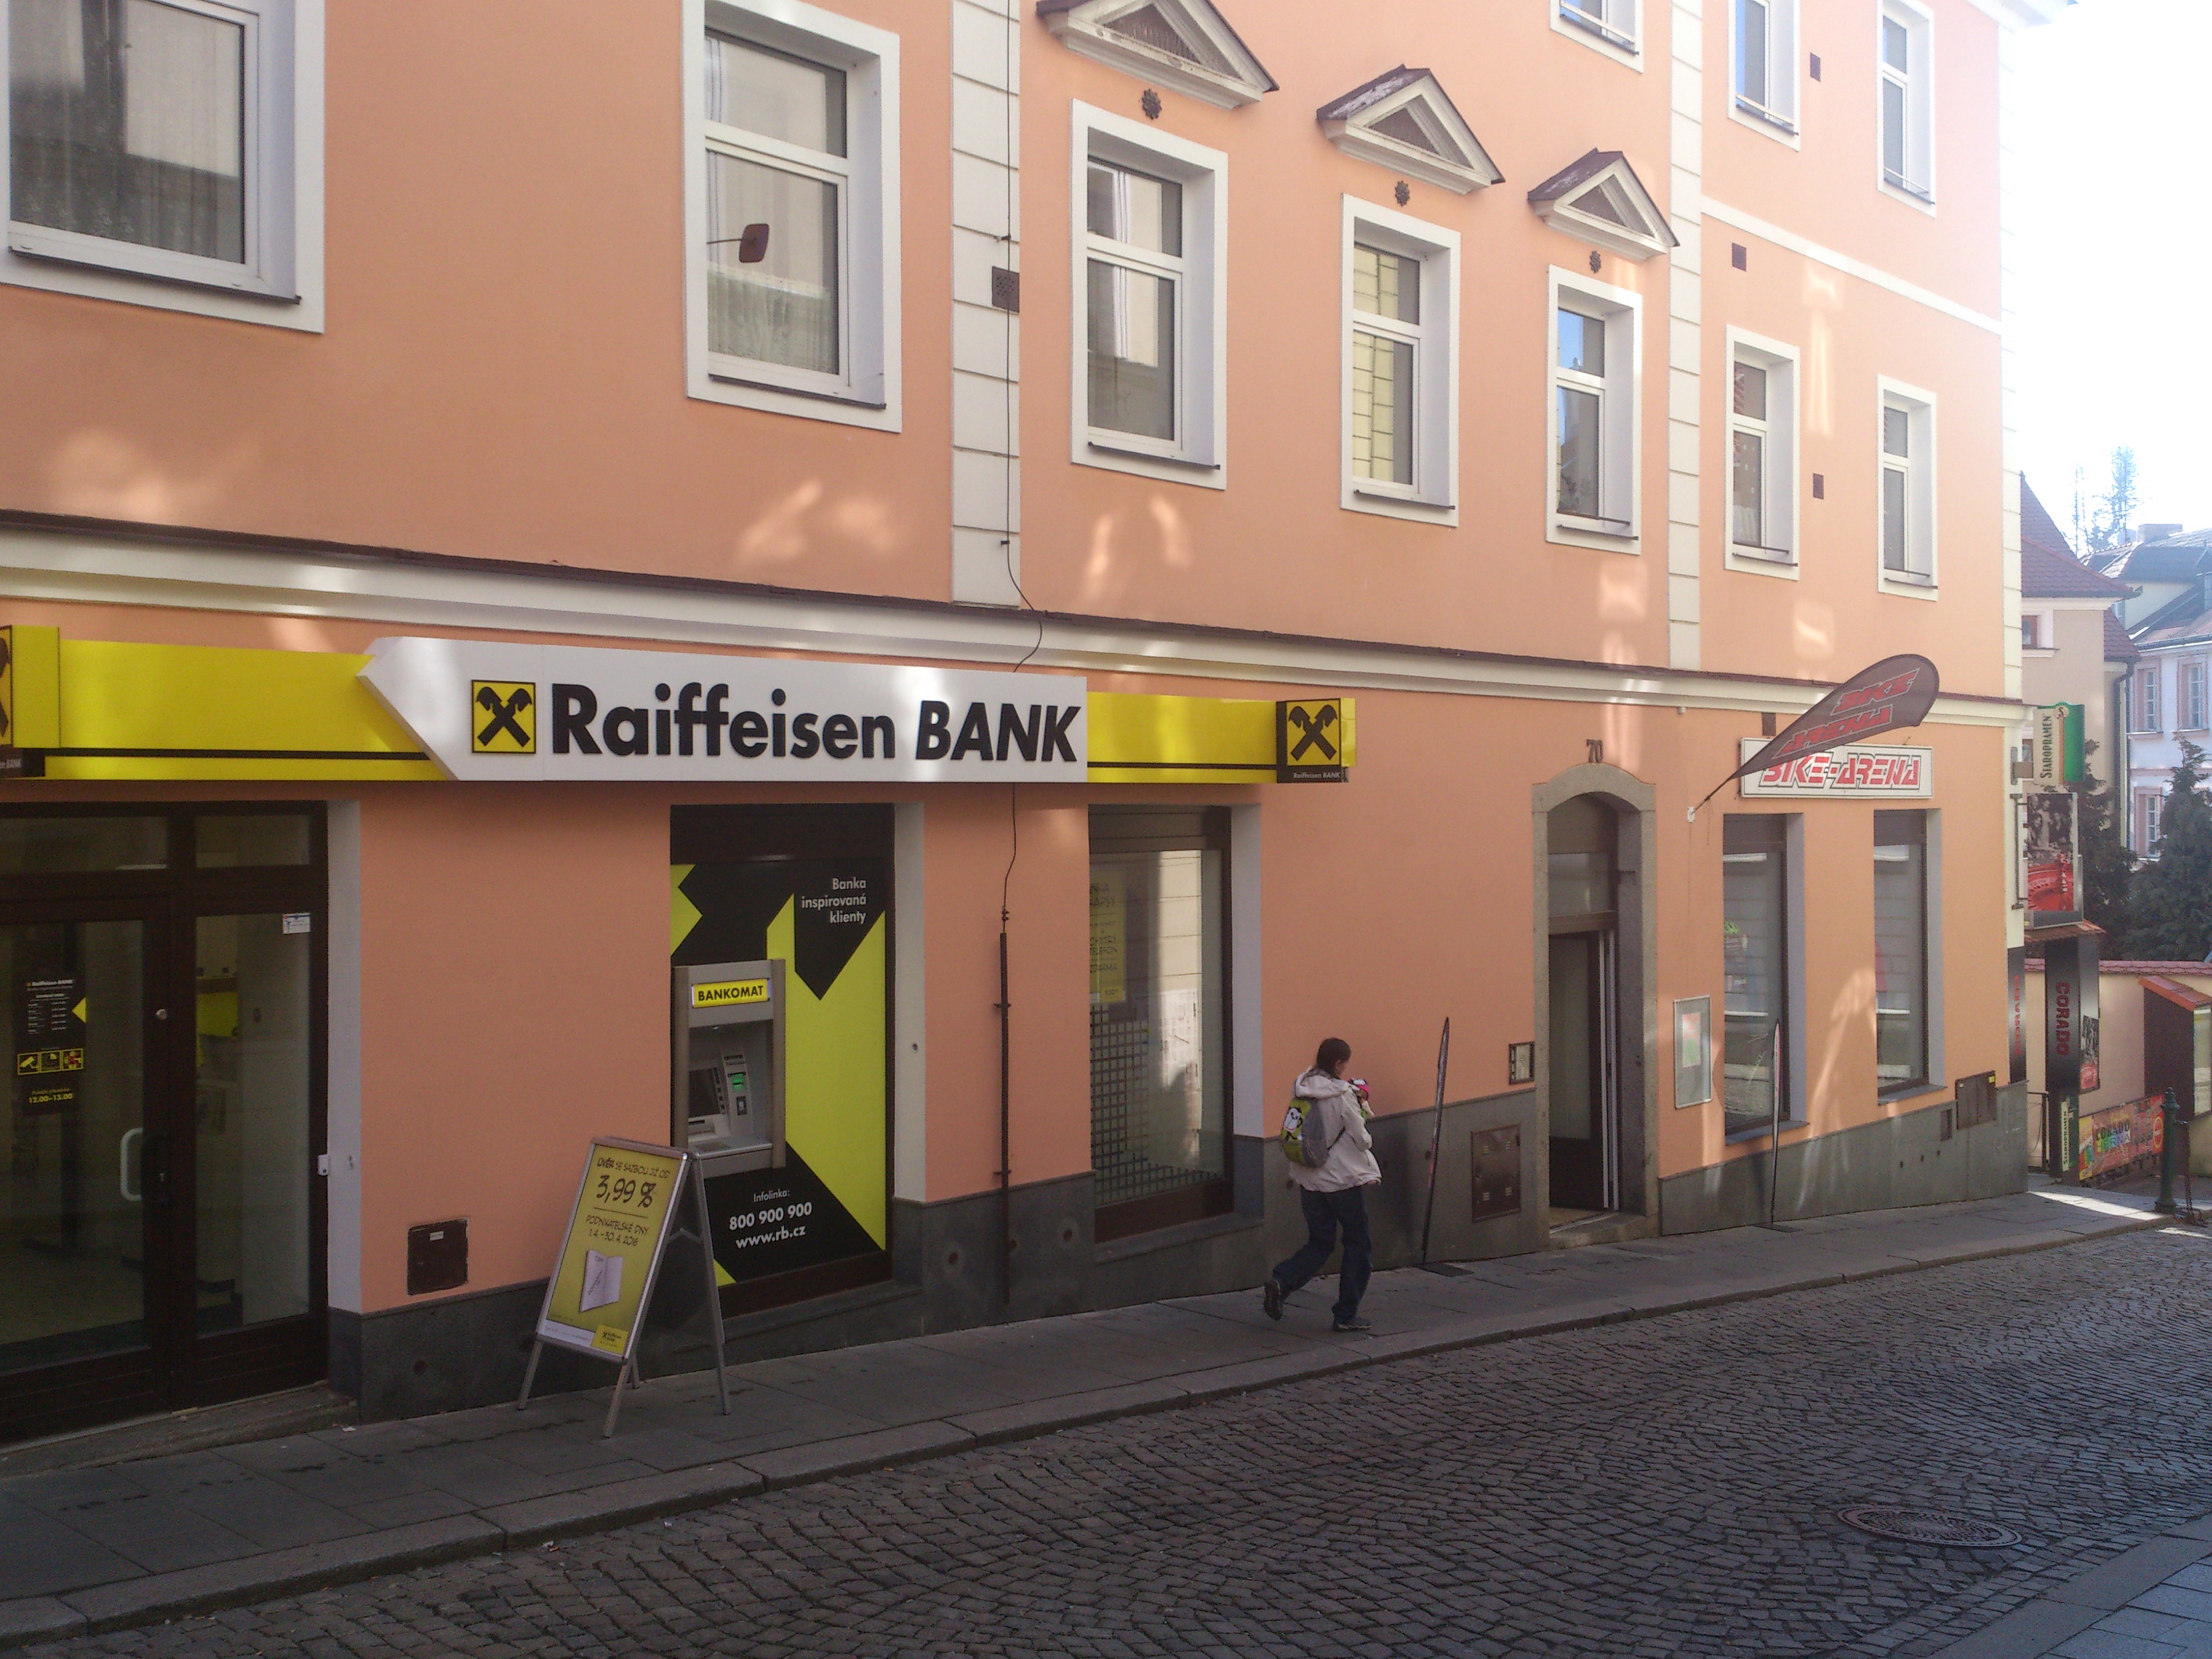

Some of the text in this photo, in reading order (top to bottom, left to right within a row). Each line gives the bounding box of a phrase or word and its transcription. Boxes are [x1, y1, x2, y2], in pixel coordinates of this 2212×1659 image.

[1832, 670, 1919, 714] BIKE
[552, 682, 1082, 762] Raiffeisen BANK
[1775, 706, 1892, 755] ARENA
[1586, 739, 1603, 763] 70
[2040, 715, 2053, 779] STAROPRAMEN
[1761, 753, 1921, 787] BIKE-ARENA
[832, 877, 867, 890] Banka
[802, 893, 867, 911] inspirovaná
[830, 910, 867, 925] klienty
[698, 985, 764, 1001] BANKOMAT
[2056, 982, 2070, 1056] CORADO
[597, 1175, 636, 1203] 3,99
[753, 1189, 790, 1203] Infolinka:
[729, 1202, 812, 1230] 800 900 900
[634, 1224, 649, 1235] DNY
[735, 1225, 806, 1249] www.rb.cz
